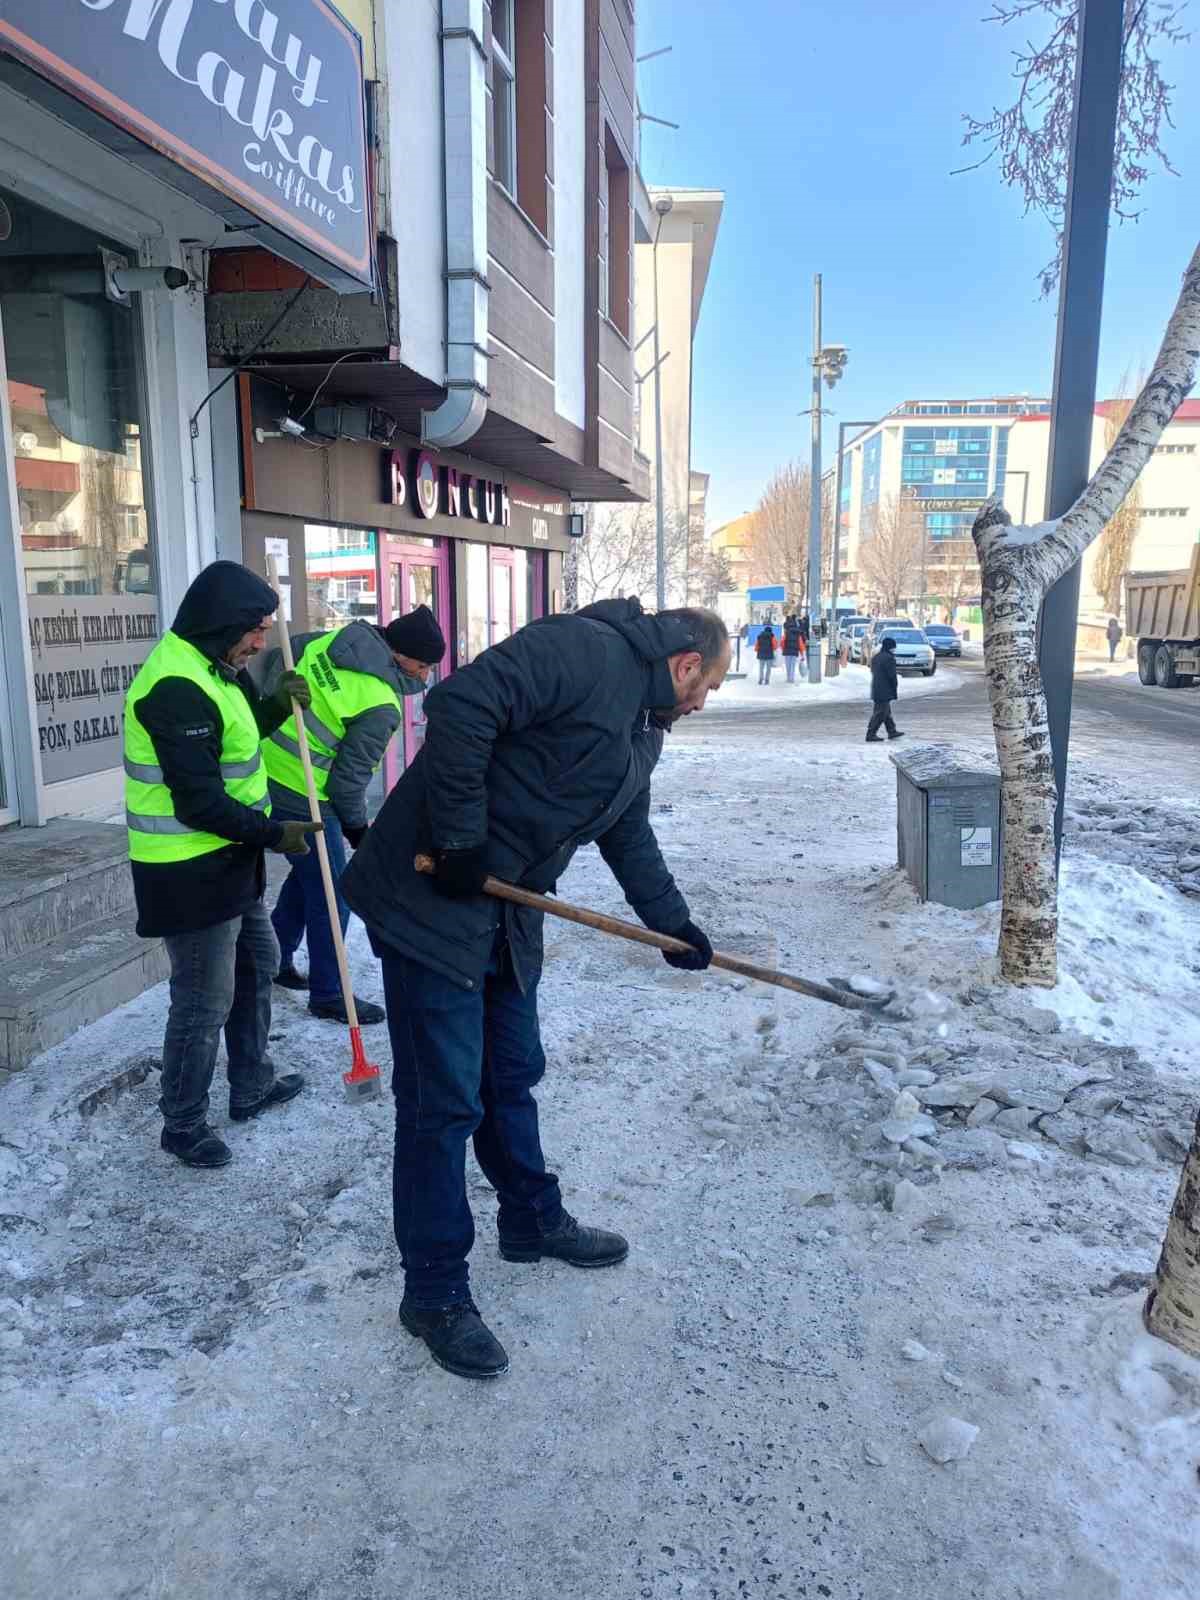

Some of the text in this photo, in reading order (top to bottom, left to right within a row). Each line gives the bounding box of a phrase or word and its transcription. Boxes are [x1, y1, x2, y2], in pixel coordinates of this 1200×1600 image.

[211, 0, 329, 107] ay
[242, 142, 337, 225] Coiffure
[34, 671, 55, 713] SAÇ
[74, 715, 119, 744] SAKAL
